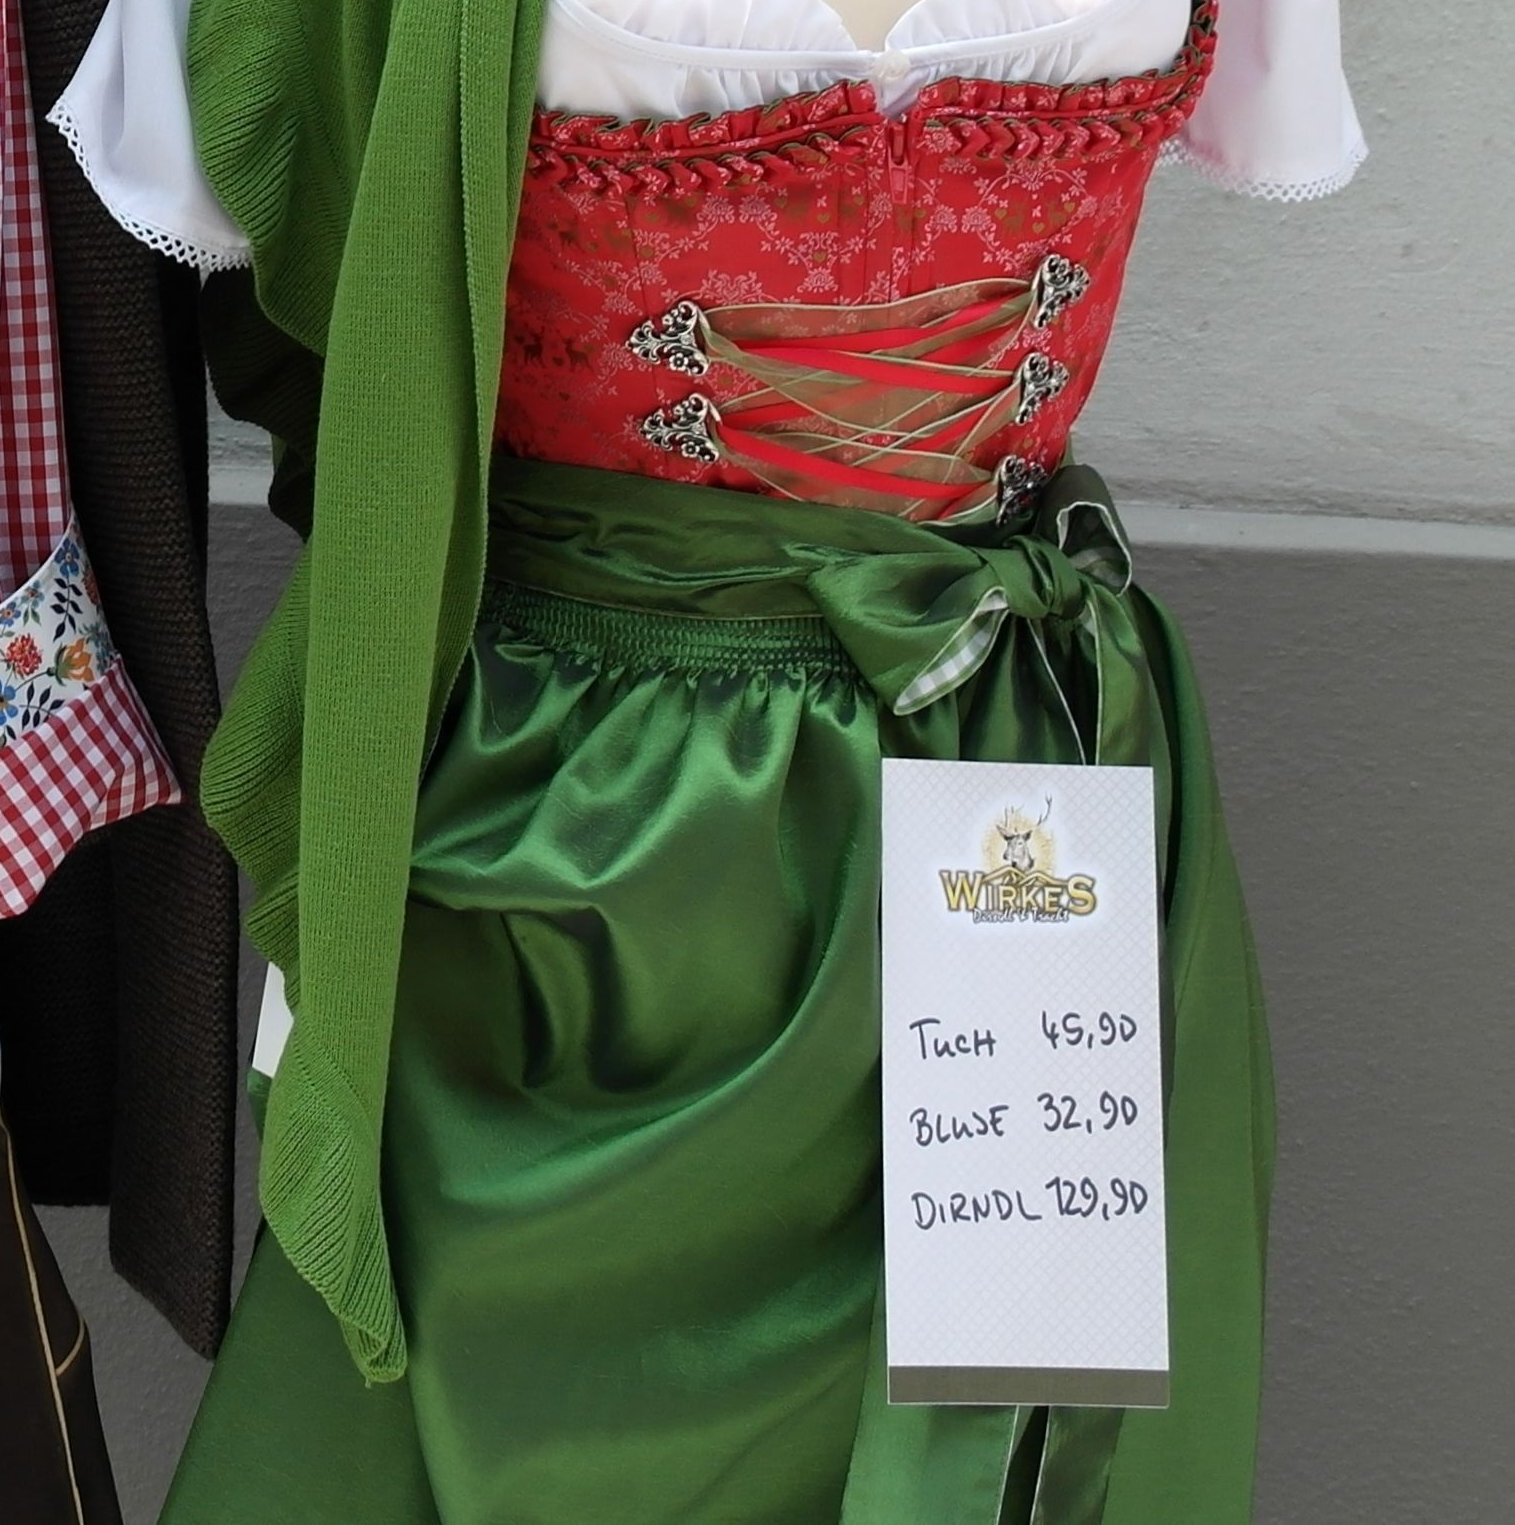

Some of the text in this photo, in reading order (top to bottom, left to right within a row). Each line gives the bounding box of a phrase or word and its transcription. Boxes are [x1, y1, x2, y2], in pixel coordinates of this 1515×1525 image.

[939, 869, 1097, 916] WIRKES
[1041, 1010, 1138, 1050] 45,90
[1036, 1090, 1138, 1135] 32,90
[911, 1176, 1149, 1231] DIRNDL 129,90
